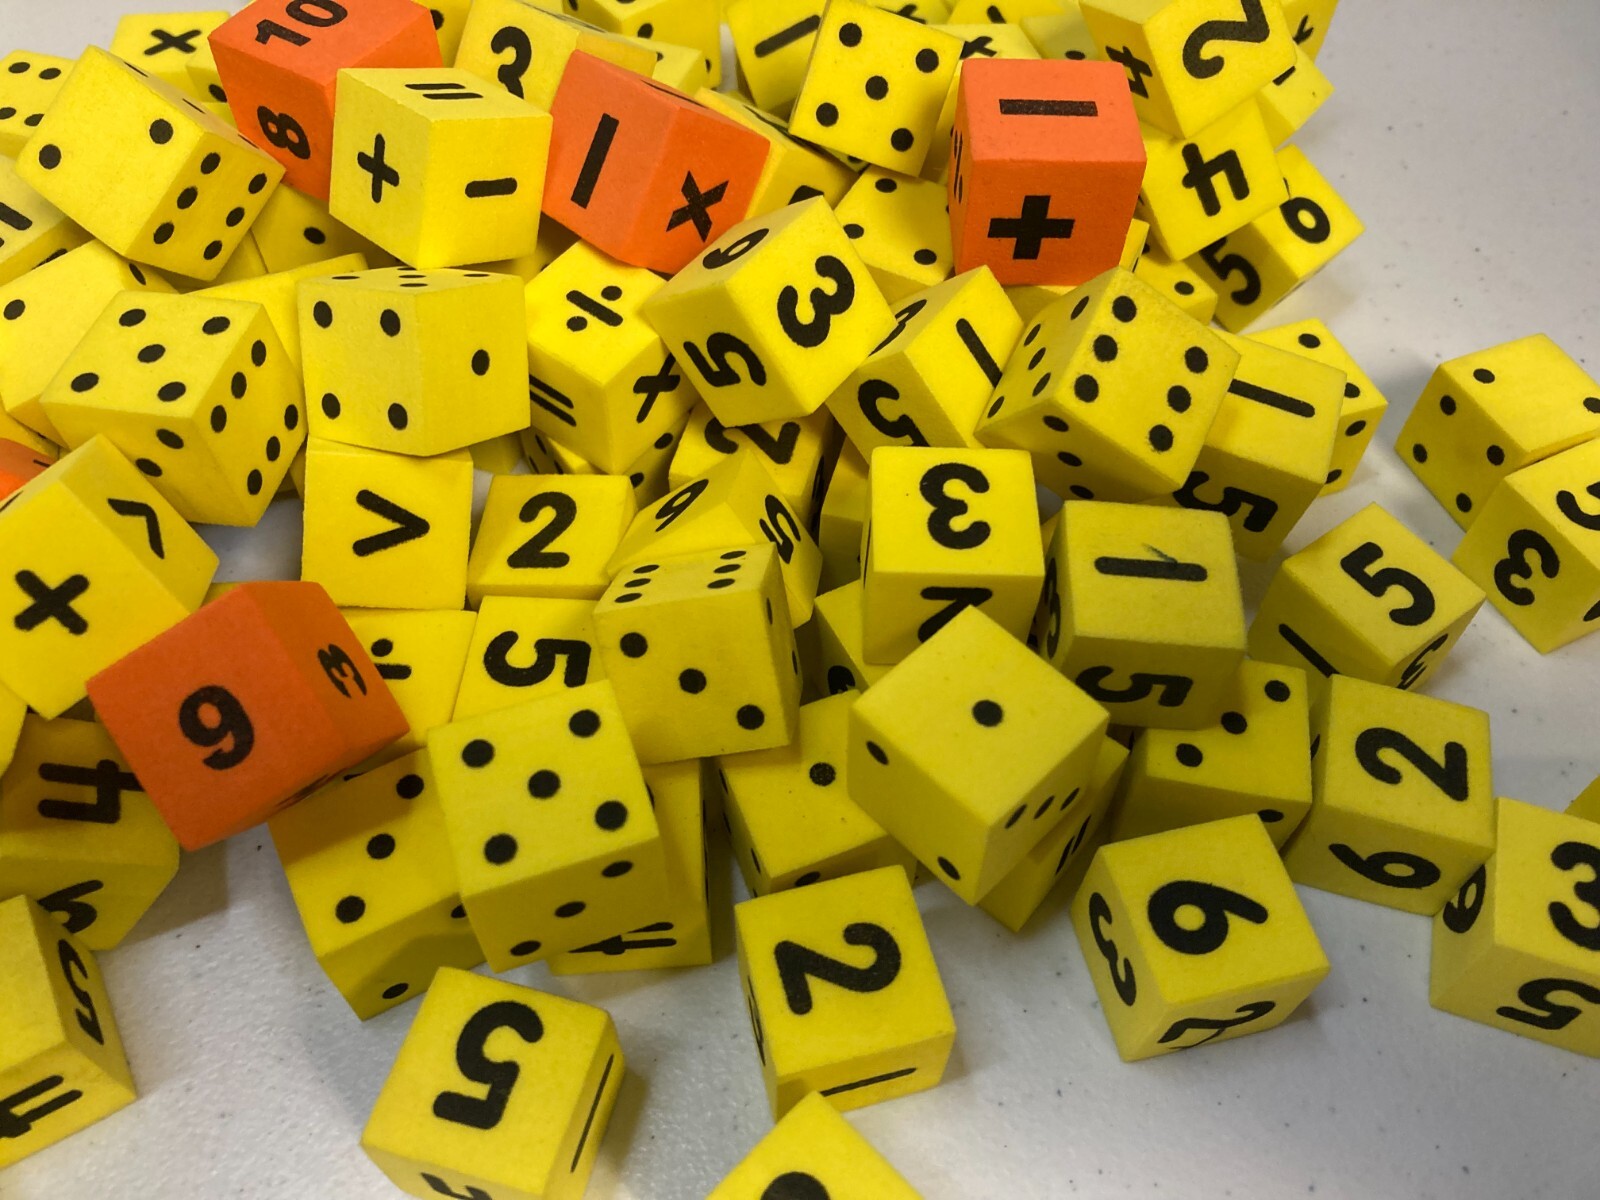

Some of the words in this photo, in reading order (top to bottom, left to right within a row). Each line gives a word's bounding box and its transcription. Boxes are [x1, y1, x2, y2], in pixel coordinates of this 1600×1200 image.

[256, 0, 347, 46] 10
[257, 106, 310, 159] 8
[1182, 143, 1249, 216] 4
[777, 256, 854, 348] 3
[1196, 236, 1261, 305] 5
[684, 332, 766, 387] 5
[507, 492, 576, 568] 2
[920, 463, 990, 549] 3
[1171, 470, 1278, 532] 5
[1340, 542, 1435, 626] 5
[1494, 529, 1560, 605] 3
[318, 645, 366, 696] 3
[484, 631, 591, 687] 5
[1070, 666, 1193, 707] 5
[1355, 728, 1468, 801] 2
[1549, 842, 1600, 951] 3
[774, 923, 901, 1015] 2
[1089, 893, 1136, 1006] 3
[1496, 978, 1600, 1029] 5
[433, 1001, 543, 1129] 5
